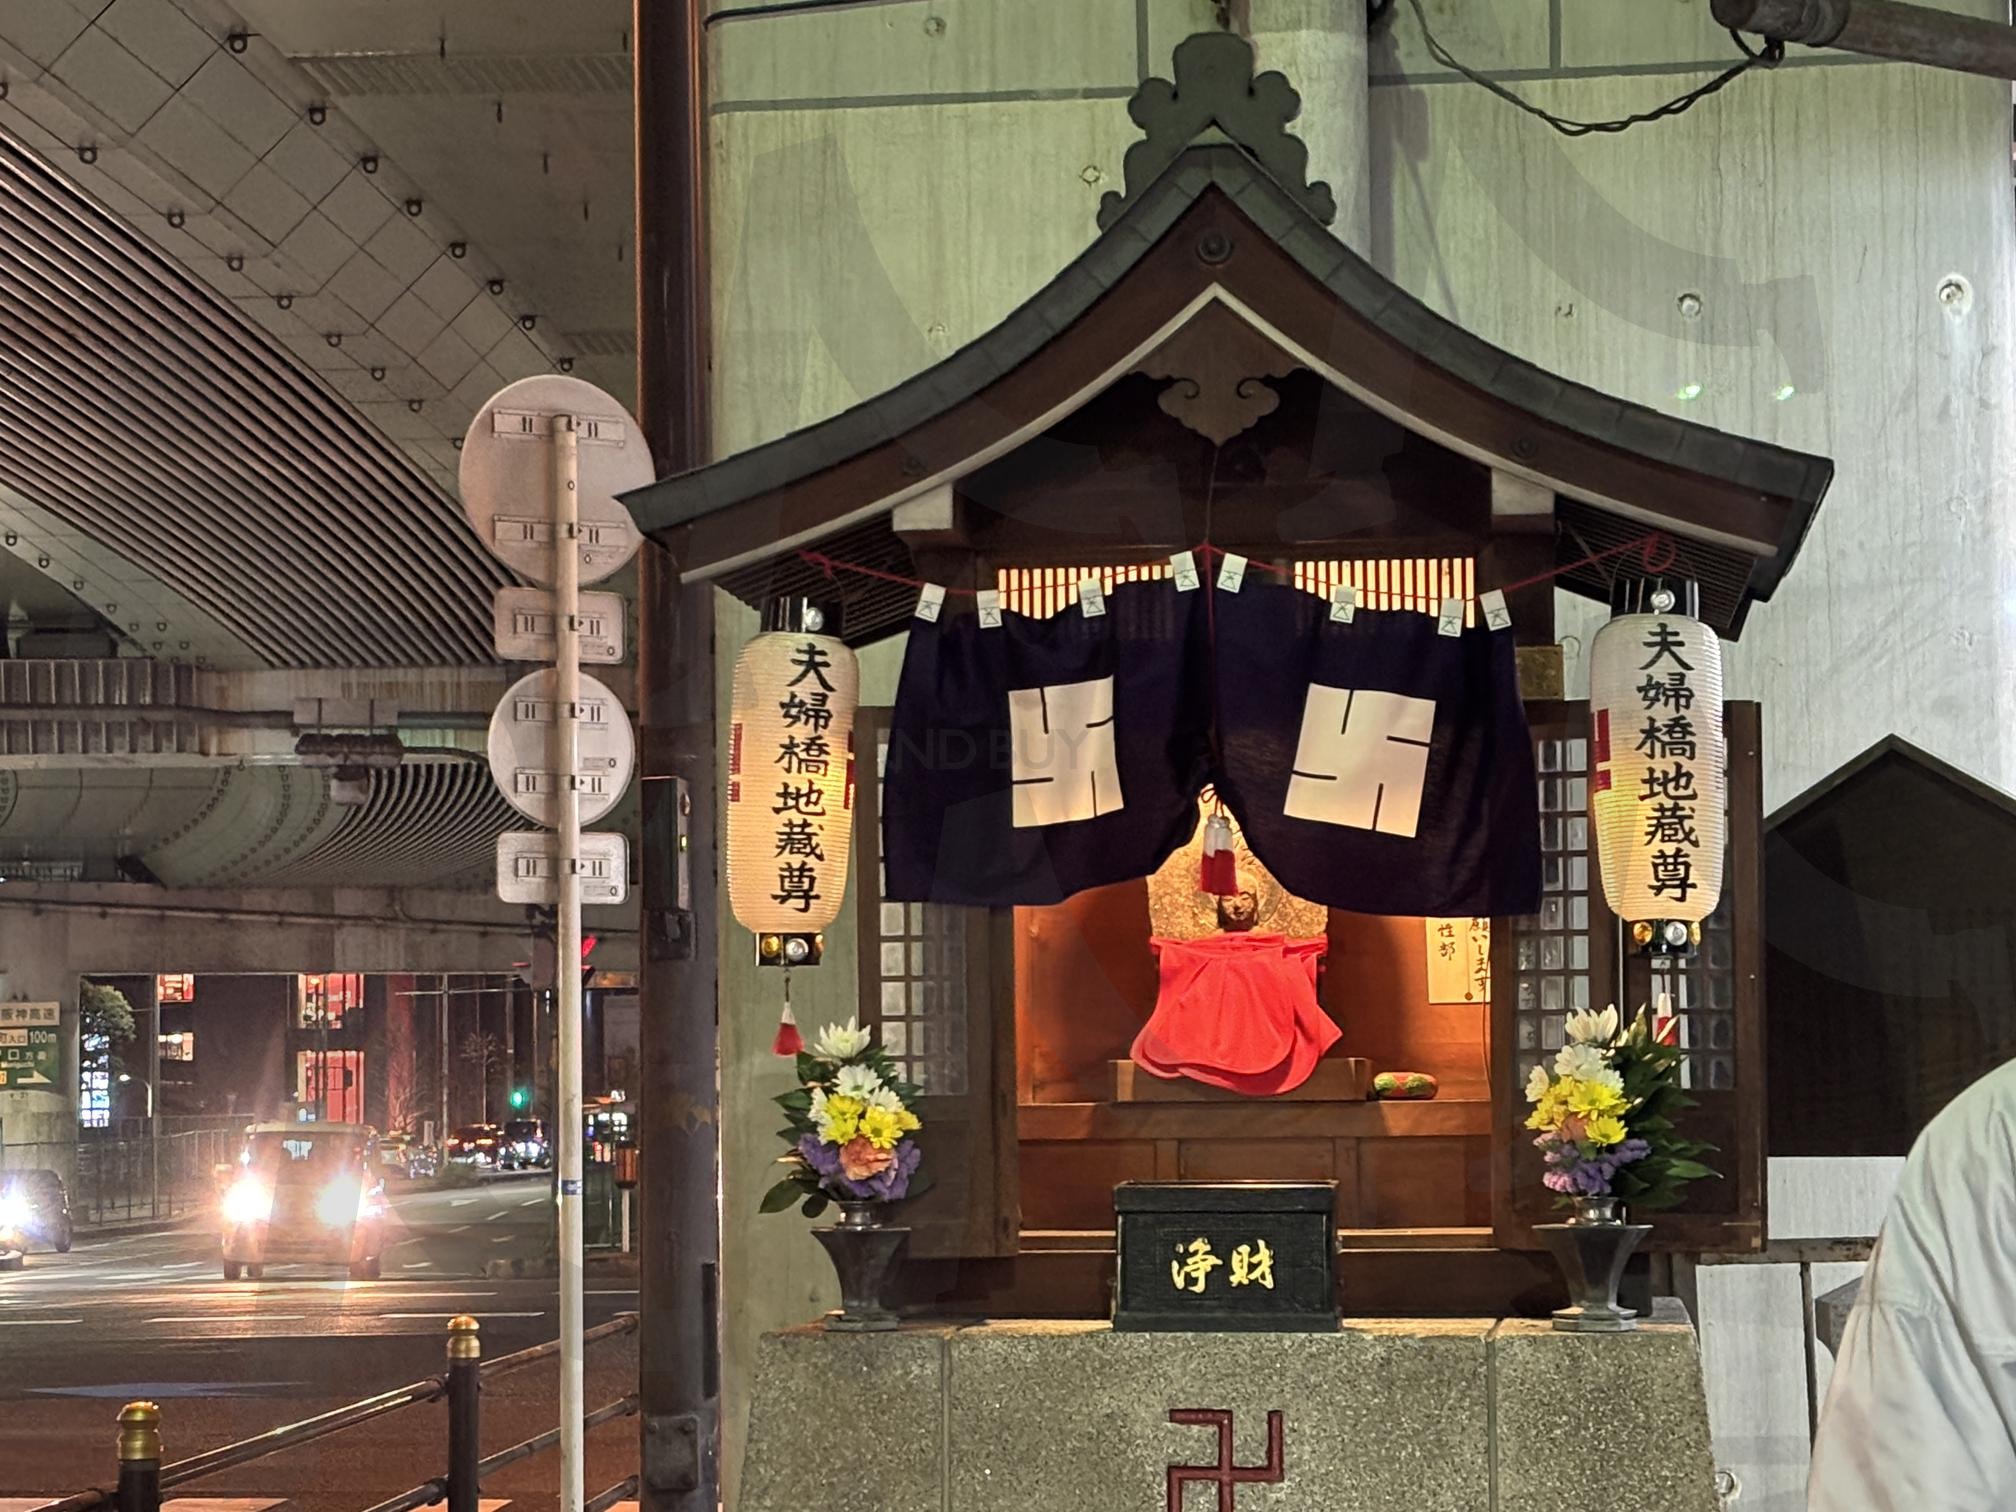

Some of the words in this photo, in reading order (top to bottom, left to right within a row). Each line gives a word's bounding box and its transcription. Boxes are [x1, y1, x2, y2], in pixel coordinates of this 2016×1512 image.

[771, 643, 836, 913] 夫婦橋地蔵尊
[1635, 622, 1700, 902] 夫婦橋地蔵尊
[29, 1030, 57, 1044] 100m
[1171, 1237, 1274, 1293] 浄財
